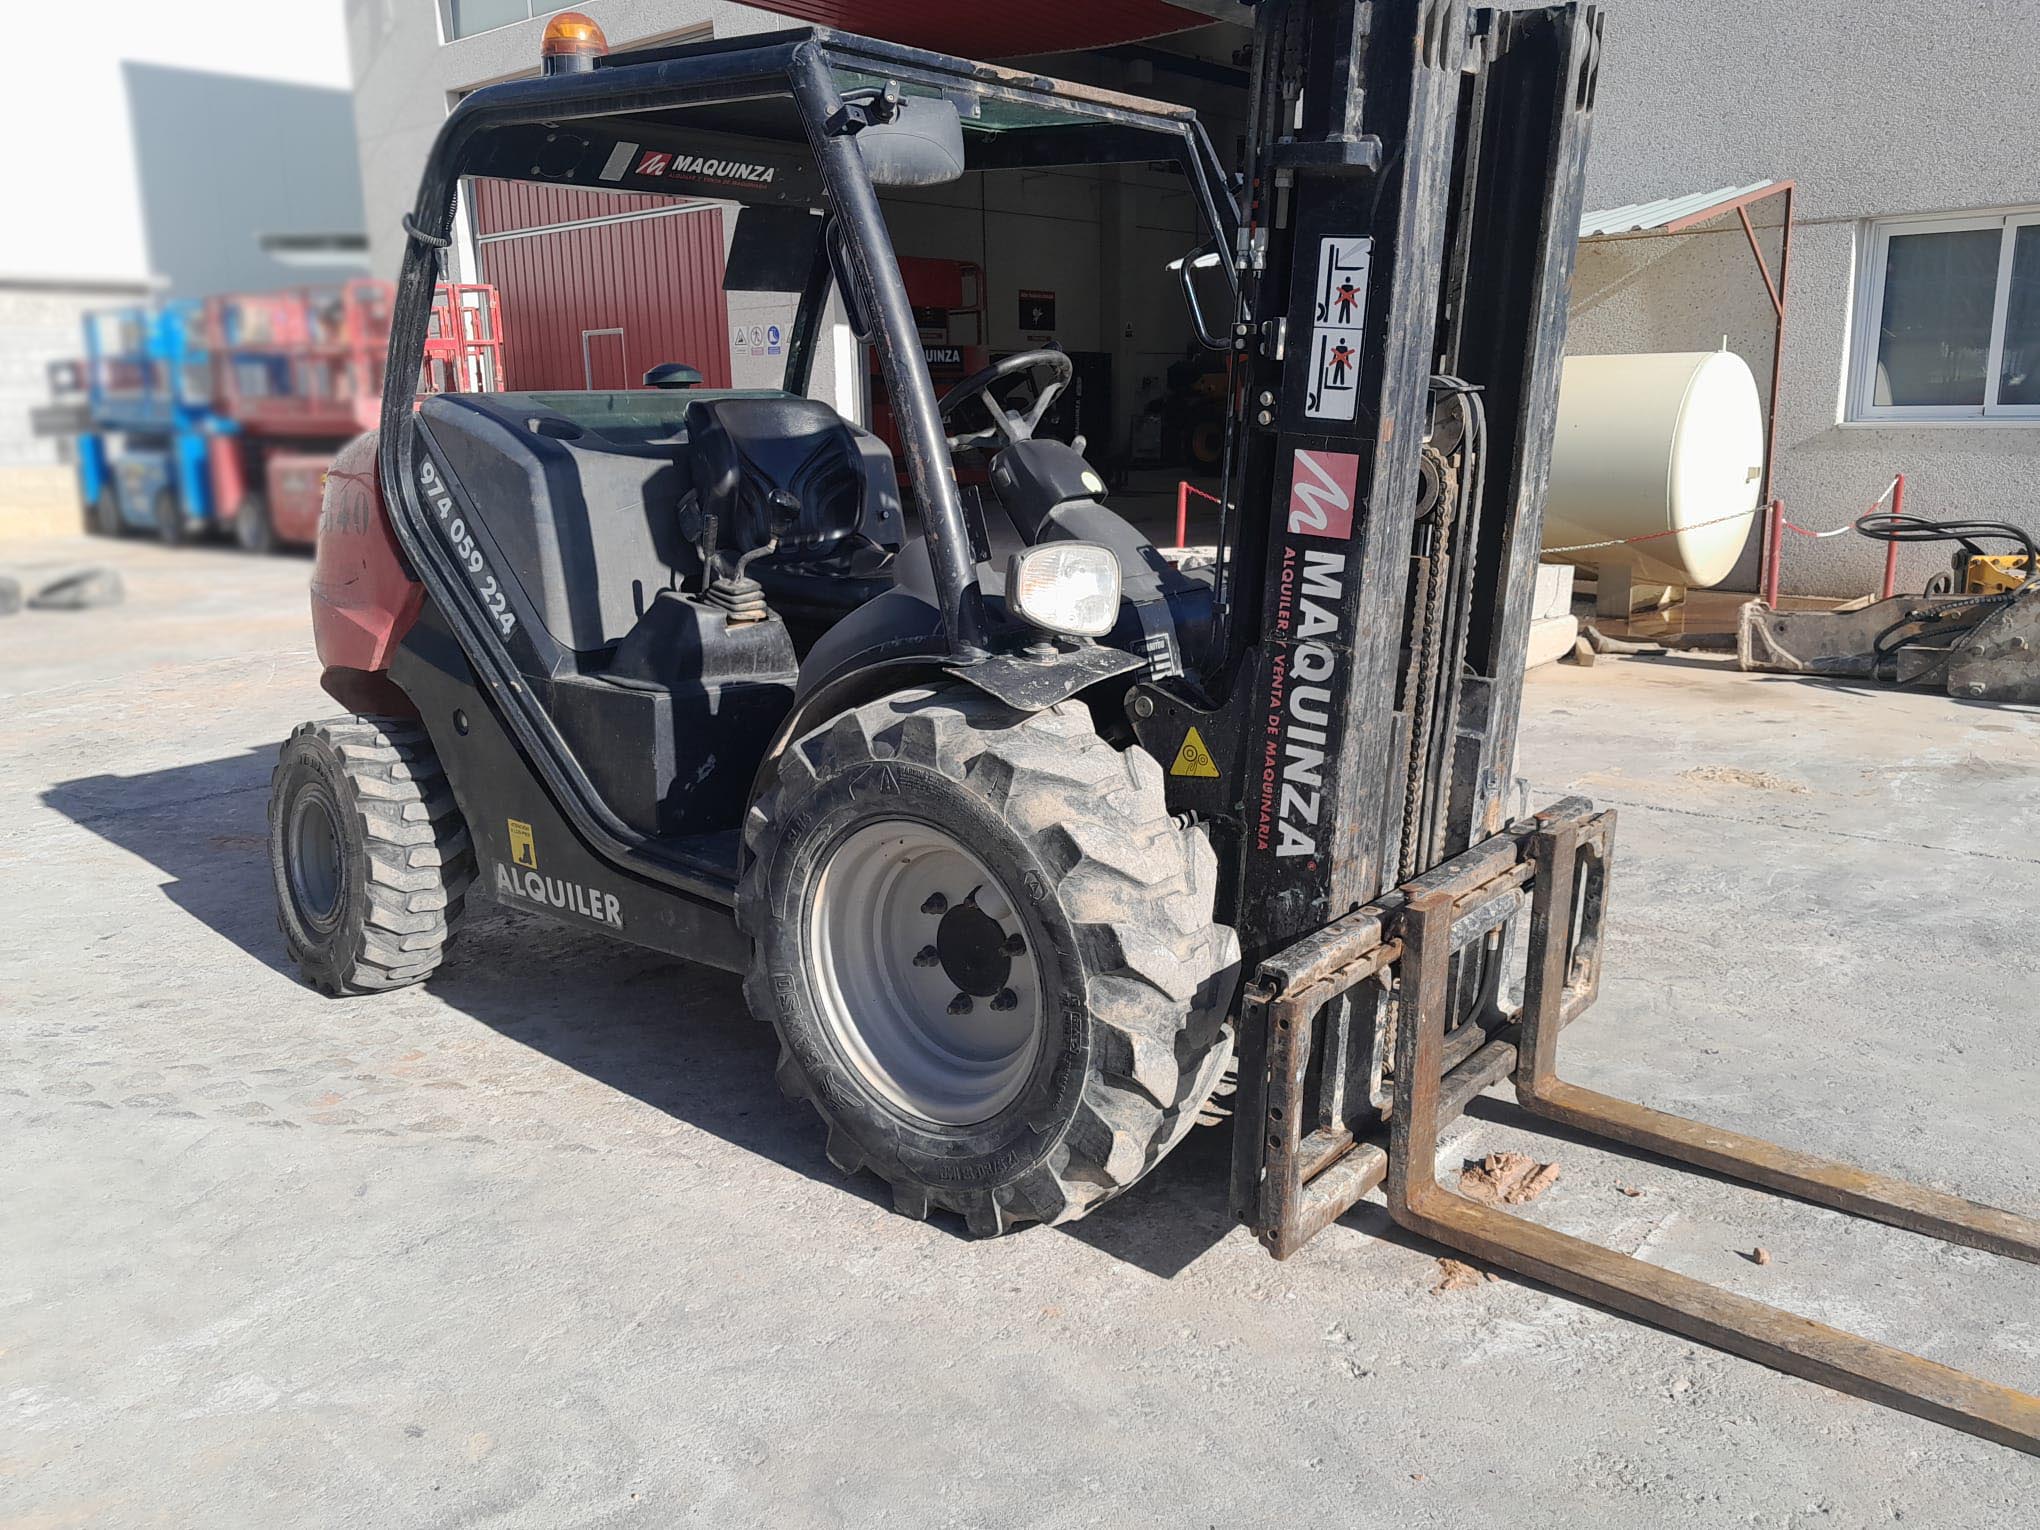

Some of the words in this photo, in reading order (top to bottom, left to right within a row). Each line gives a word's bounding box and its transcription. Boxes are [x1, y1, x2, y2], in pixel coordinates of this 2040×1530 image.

[672, 154, 775, 183] MAQUINZA
[925, 348, 961, 363] UINZA
[419, 461, 454, 520] 974
[450, 517, 484, 574] 059
[479, 575, 518, 635] 224
[1276, 545, 1297, 631] ALQUILER
[1268, 654, 1287, 710] VENTA
[1275, 549, 1346, 858] MAQUINZA
[1266, 715, 1281, 736] DE
[1256, 742, 1278, 851] MAQUINARIA
[496, 862, 623, 929] ALQUILER
